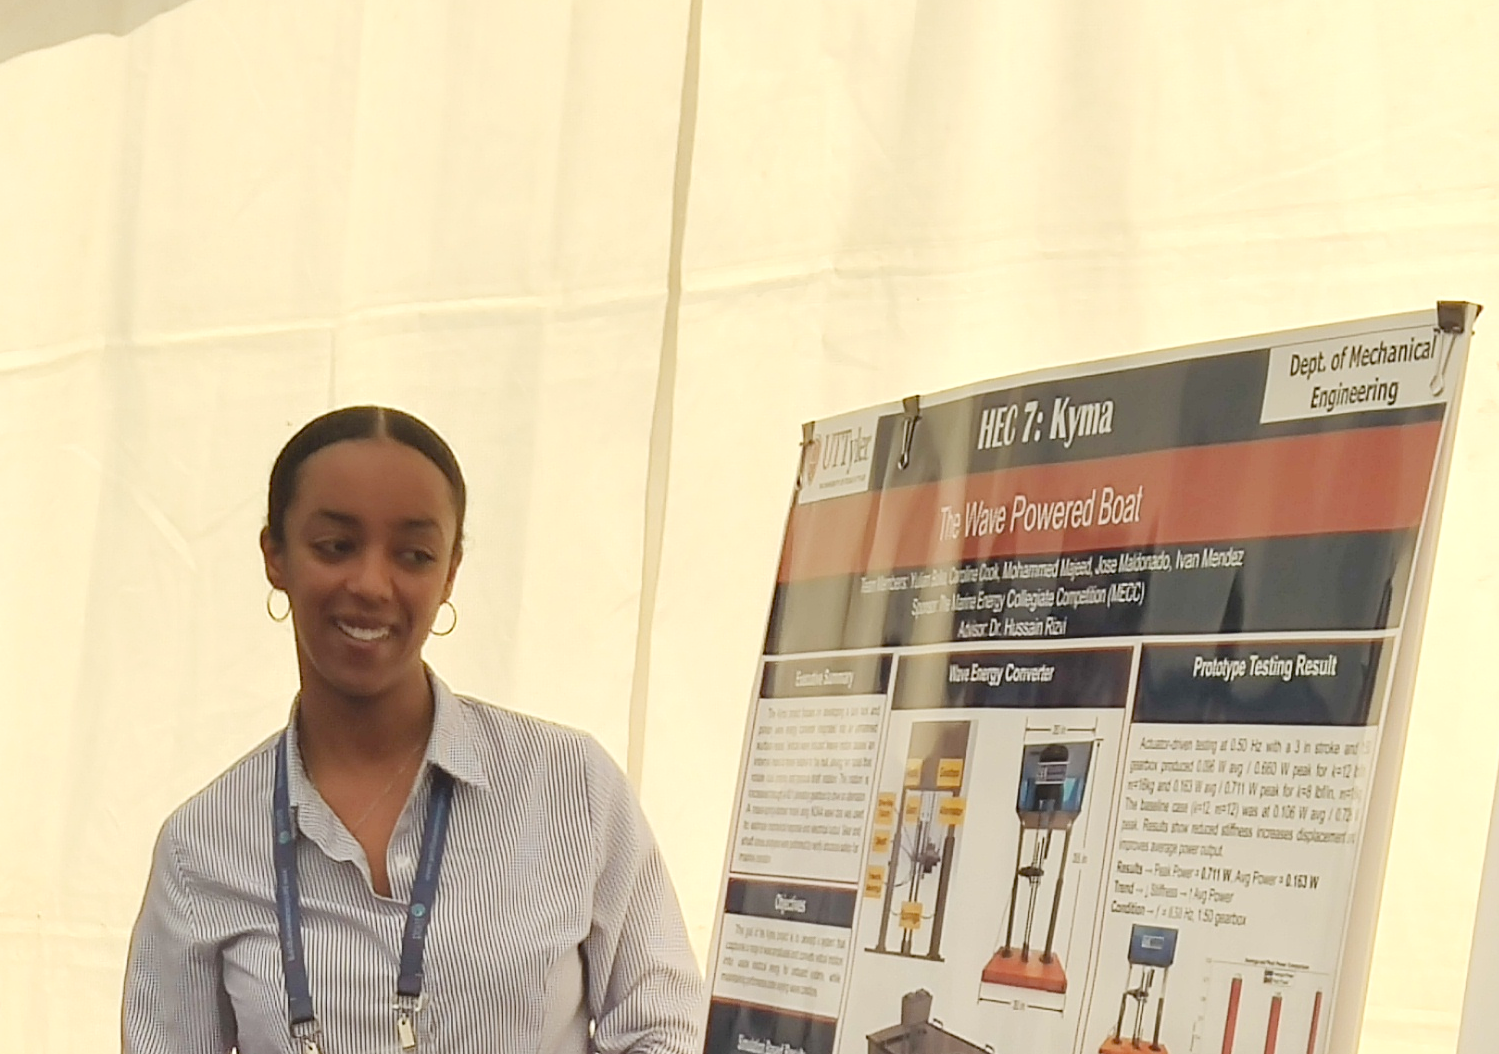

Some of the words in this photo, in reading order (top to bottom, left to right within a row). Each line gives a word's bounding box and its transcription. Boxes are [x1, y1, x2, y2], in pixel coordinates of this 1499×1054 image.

[1290, 353, 1326, 380] Dept.
[1331, 346, 1348, 370] of
[1349, 333, 1436, 369] Mechanical
[1311, 377, 1399, 412] Engineering
[978, 404, 1018, 450] HEC
[1022, 400, 1044, 442] 7:
[1049, 397, 1114, 448] Kyma
[940, 506, 961, 541] The
[965, 501, 1006, 538] Wave
[1010, 489, 1096, 534] Powered
[1097, 485, 1143, 526] Boat
[1002, 559, 1059, 579] Mohammed
[1060, 556, 1093, 582] Majeed,
[1095, 555, 1118, 575] Jose
[1118, 551, 1172, 574] Maldonado,
[1176, 549, 1200, 569] Ivan
[1201, 546, 1245, 568] Mendez
[977, 591, 1006, 613] Energy
[1006, 588, 1054, 612] Collegiate
[1056, 584, 1106, 610] Competition
[1107, 581, 1145, 608] (MECC)
[1004, 617, 1043, 636] Hussain
[949, 664, 970, 682] Wave
[970, 663, 1004, 687] Energy
[1005, 662, 1055, 682] Converter
[1192, 656, 1246, 681] Prototype
[1249, 655, 1293, 681] Testing
[1295, 654, 1337, 676] Result
